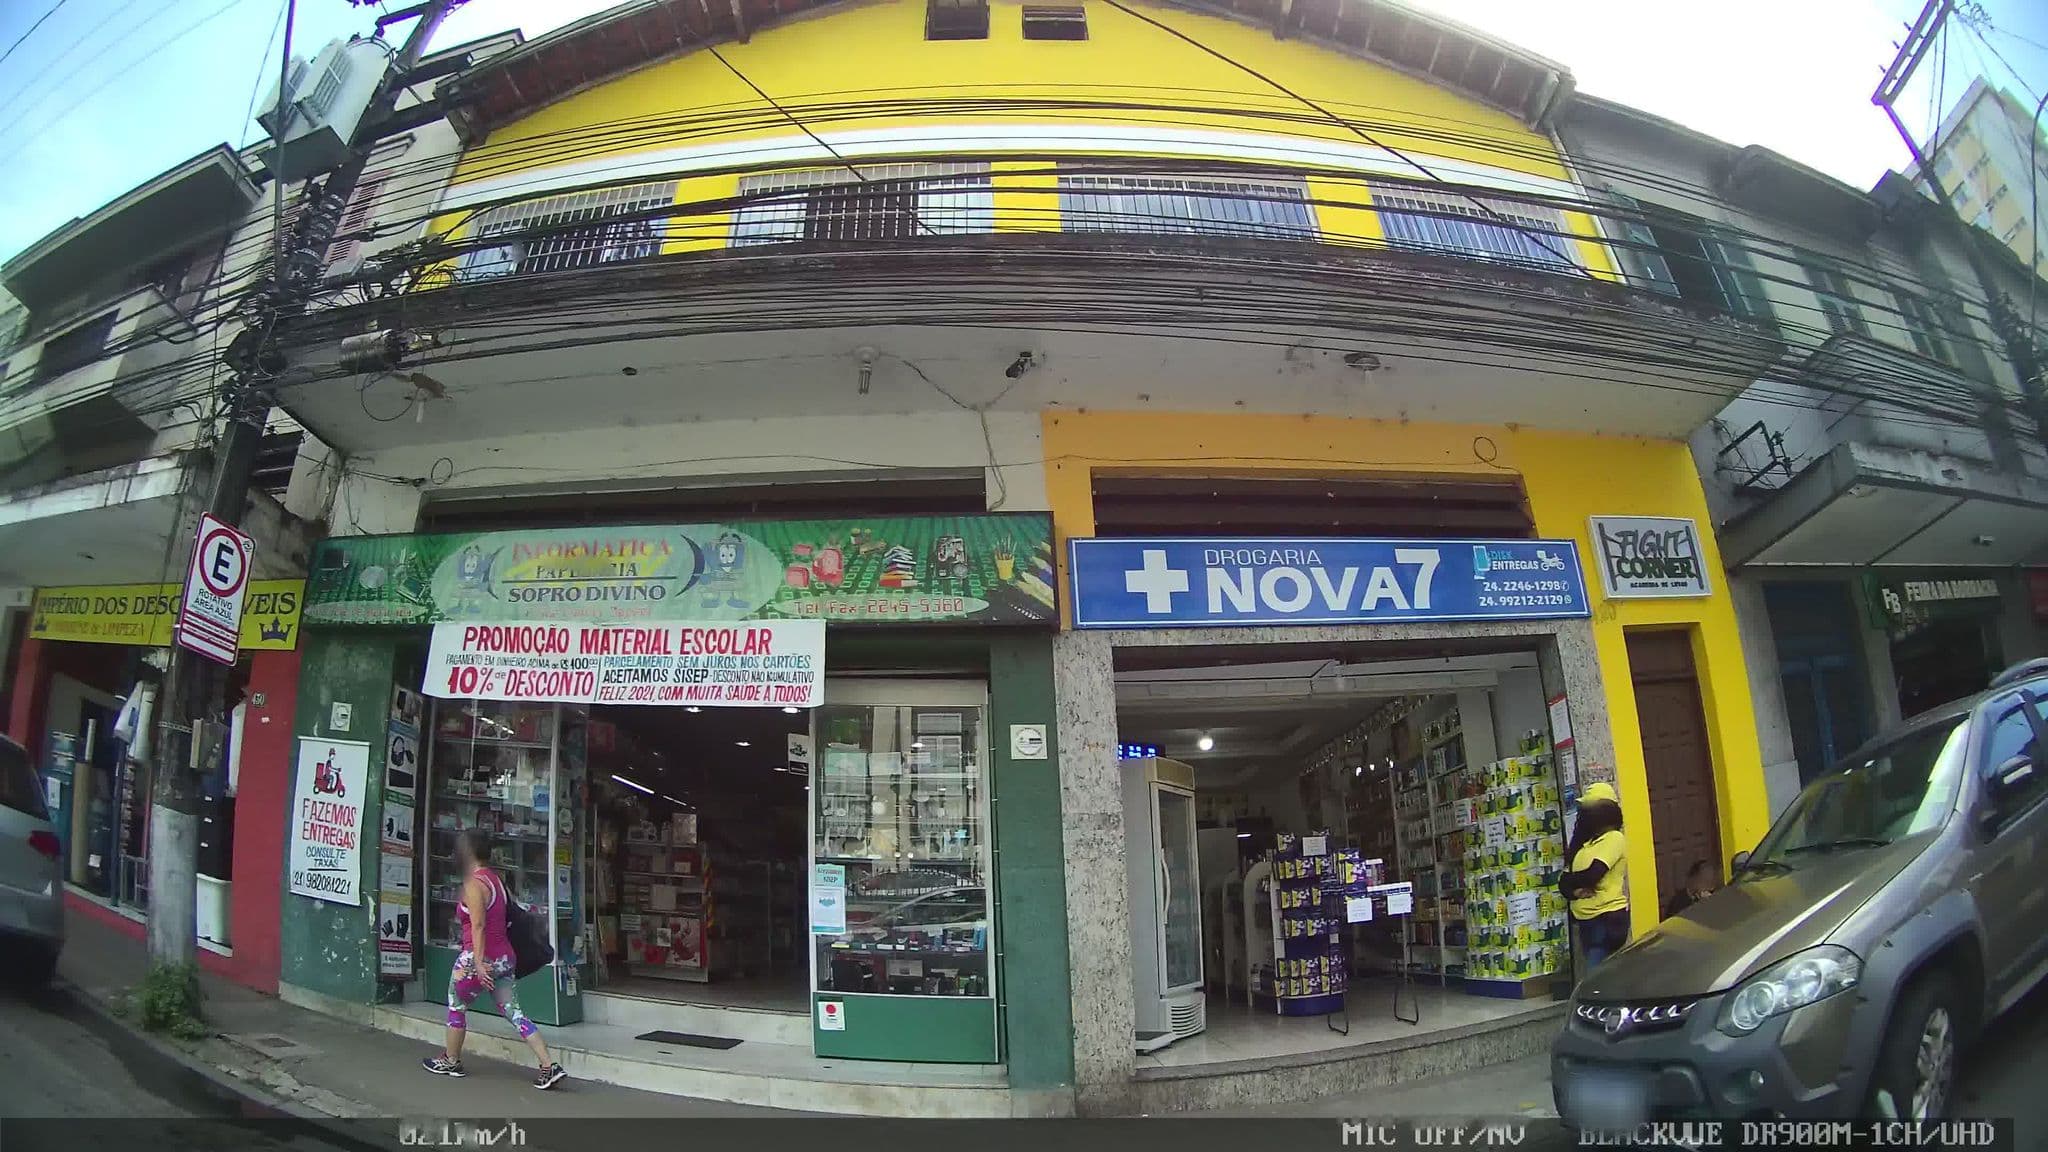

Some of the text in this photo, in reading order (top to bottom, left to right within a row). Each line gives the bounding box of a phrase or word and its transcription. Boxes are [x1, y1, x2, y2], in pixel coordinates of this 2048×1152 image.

[1615, 529, 1684, 559] FIGHT
[212, 542, 234, 584] E
[1204, 549, 1323, 566] DROGARIA
[1492, 560, 1539, 570] ENTREGAS
[1617, 556, 1696, 578] CORNER
[508, 584, 666, 603] SOPRO DIVINO
[1503, 581, 1560, 592] 2246-1298
[93, 596, 129, 615] DOS
[1500, 595, 1563, 606] 99212-2129
[214, 608, 233, 621] AZUL
[463, 624, 773, 656] PROMOÇÃO MATERIAL ESCOLAR
[446, 654, 484, 665] PAGAMENTO
[484, 656, 495, 666] EM
[528, 658, 550, 669] ACIMA
[603, 653, 812, 669] PARCELAMENTO SEM JUROS NOS CARTÕES
[448, 666, 494, 695] 10%
[504, 670, 595, 697] DESCONTO
[602, 668, 669, 684] ACEITAMOS
[673, 669, 709, 684] SISEP
[600, 686, 627, 701] FELIZ
[658, 686, 686, 701] COM
[686, 686, 722, 701] MUITA
[763, 686, 770, 702] A
[774, 686, 813, 703] TODOS!
[302, 798, 357, 828] FAZEMOS
[302, 821, 356, 850] ENTREGAS
[306, 846, 348, 860] CONSULTE
[314, 858, 338, 868] TAXAS
